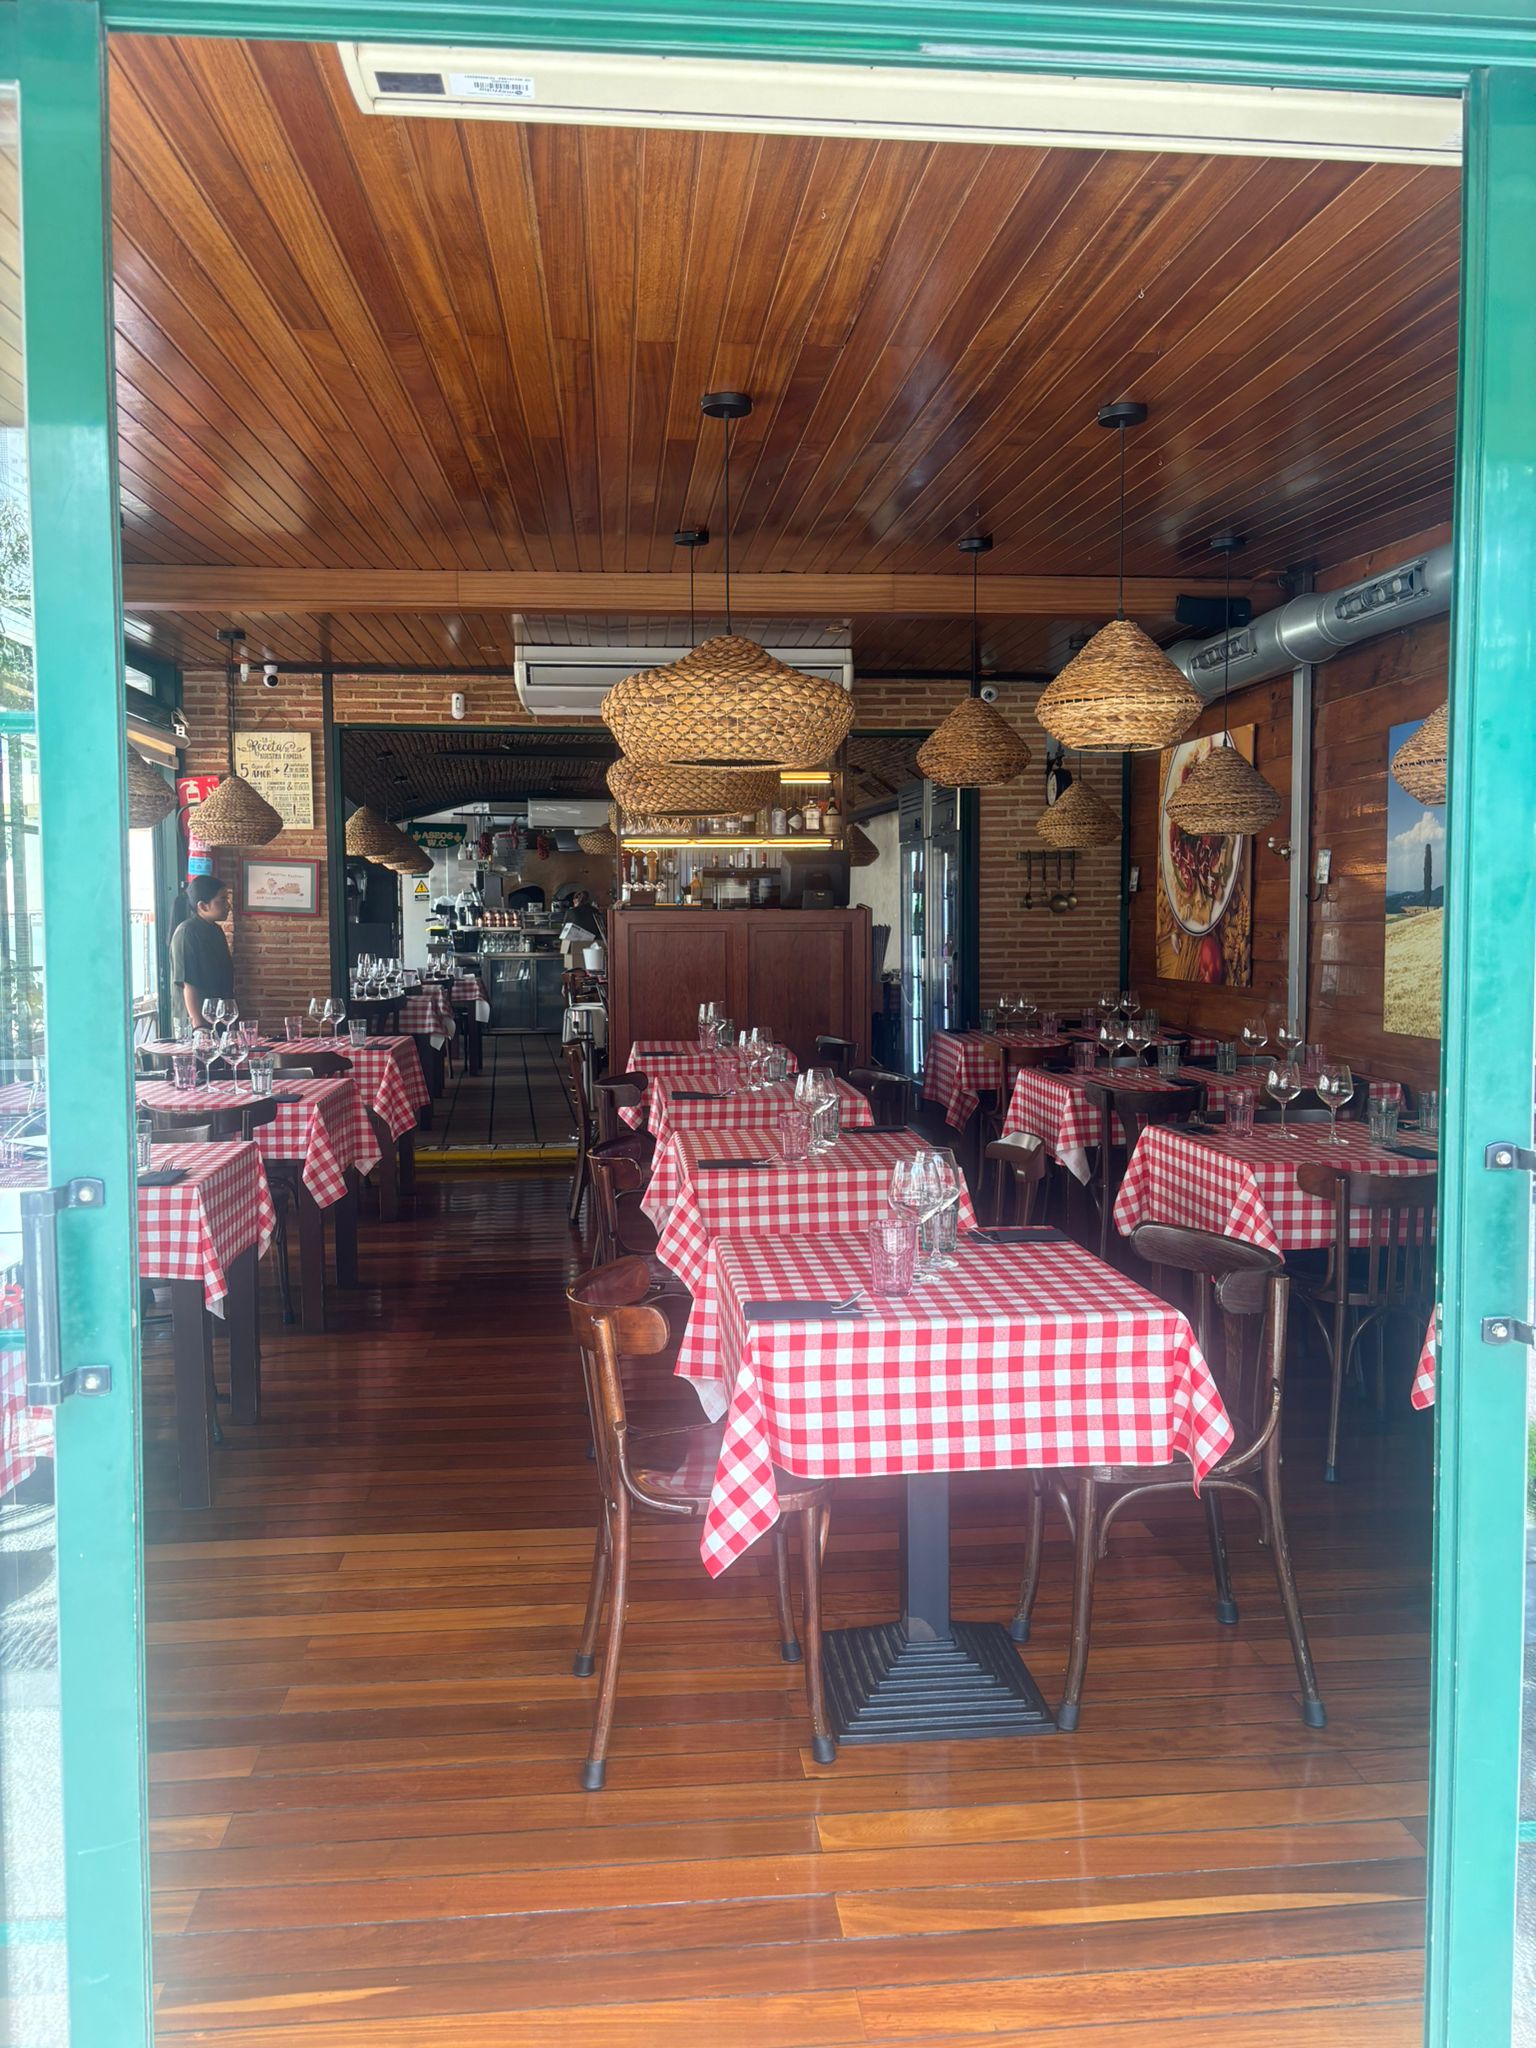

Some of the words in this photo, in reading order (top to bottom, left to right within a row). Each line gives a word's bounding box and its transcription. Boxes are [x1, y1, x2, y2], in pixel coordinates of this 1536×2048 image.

[246, 739, 296, 757] Receta
[240, 763, 249, 778] 5
[252, 770, 272, 778] AMOR
[421, 831, 454, 840] ASEOS
[477, 861, 489, 871] WC
